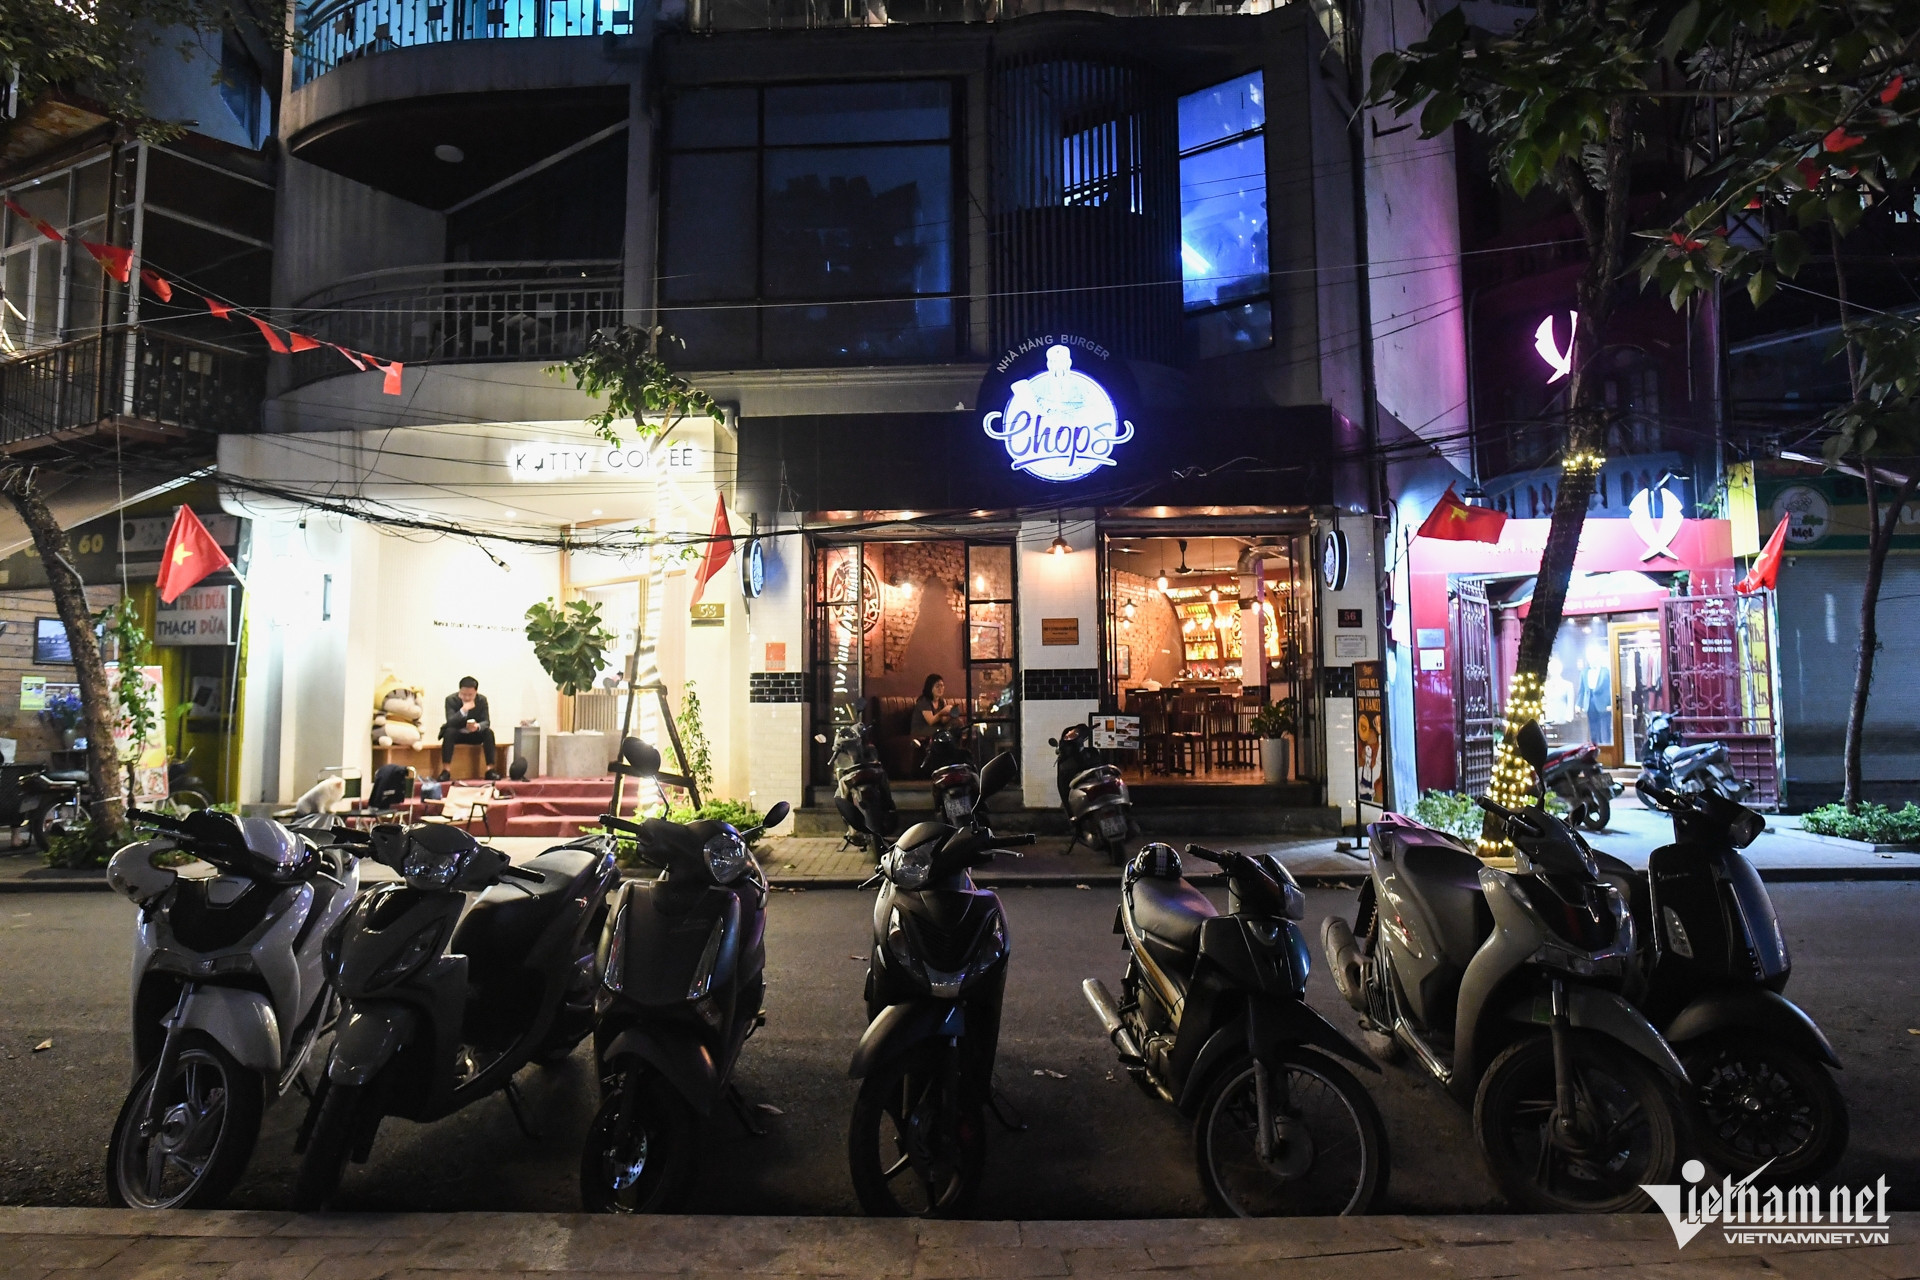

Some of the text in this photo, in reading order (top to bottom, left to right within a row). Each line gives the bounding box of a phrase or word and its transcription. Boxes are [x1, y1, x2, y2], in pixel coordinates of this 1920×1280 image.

[996, 334, 1110, 373] NHÀ HÀNG BURGER
[983, 410, 1134, 467] Chops
[607, 448, 693, 468] COEE
[78, 533, 104, 554] 60
[700, 604, 717, 617] 58
[1344, 611, 1357, 621] 56
[200, 615, 226, 635] DỪA
